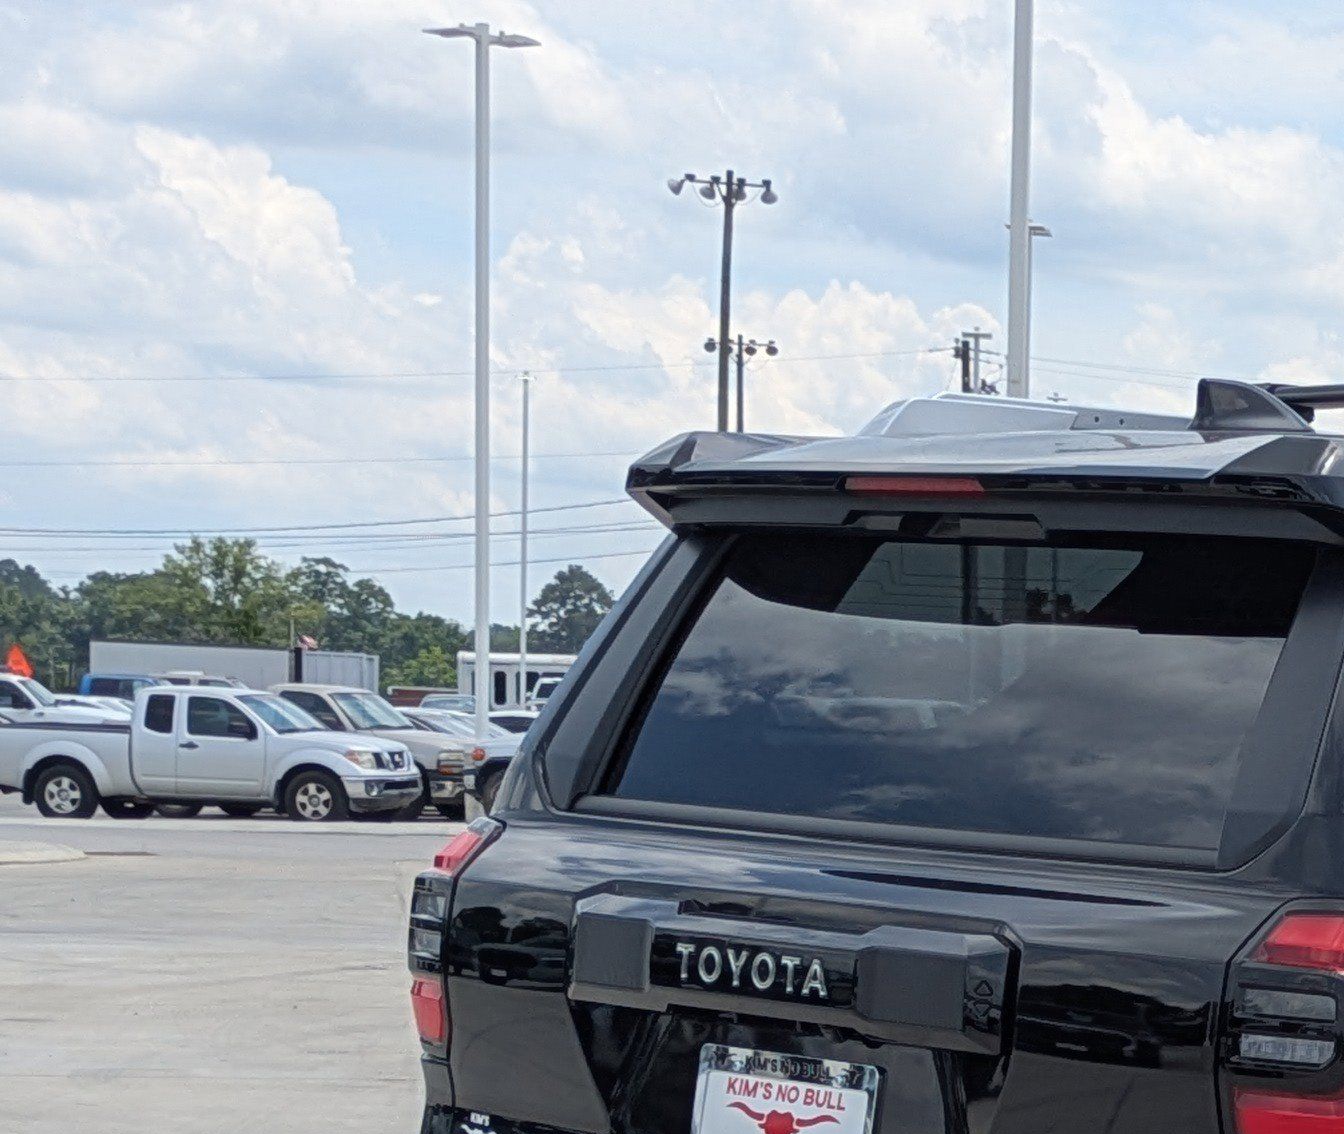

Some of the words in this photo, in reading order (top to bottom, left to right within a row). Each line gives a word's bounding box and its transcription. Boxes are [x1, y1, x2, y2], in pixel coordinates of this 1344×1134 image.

[676, 941, 830, 999] TOYOTA
[726, 1077, 773, 1100] KIM'S
[777, 1084, 800, 1103] NO
[803, 1088, 846, 1111] BULL
